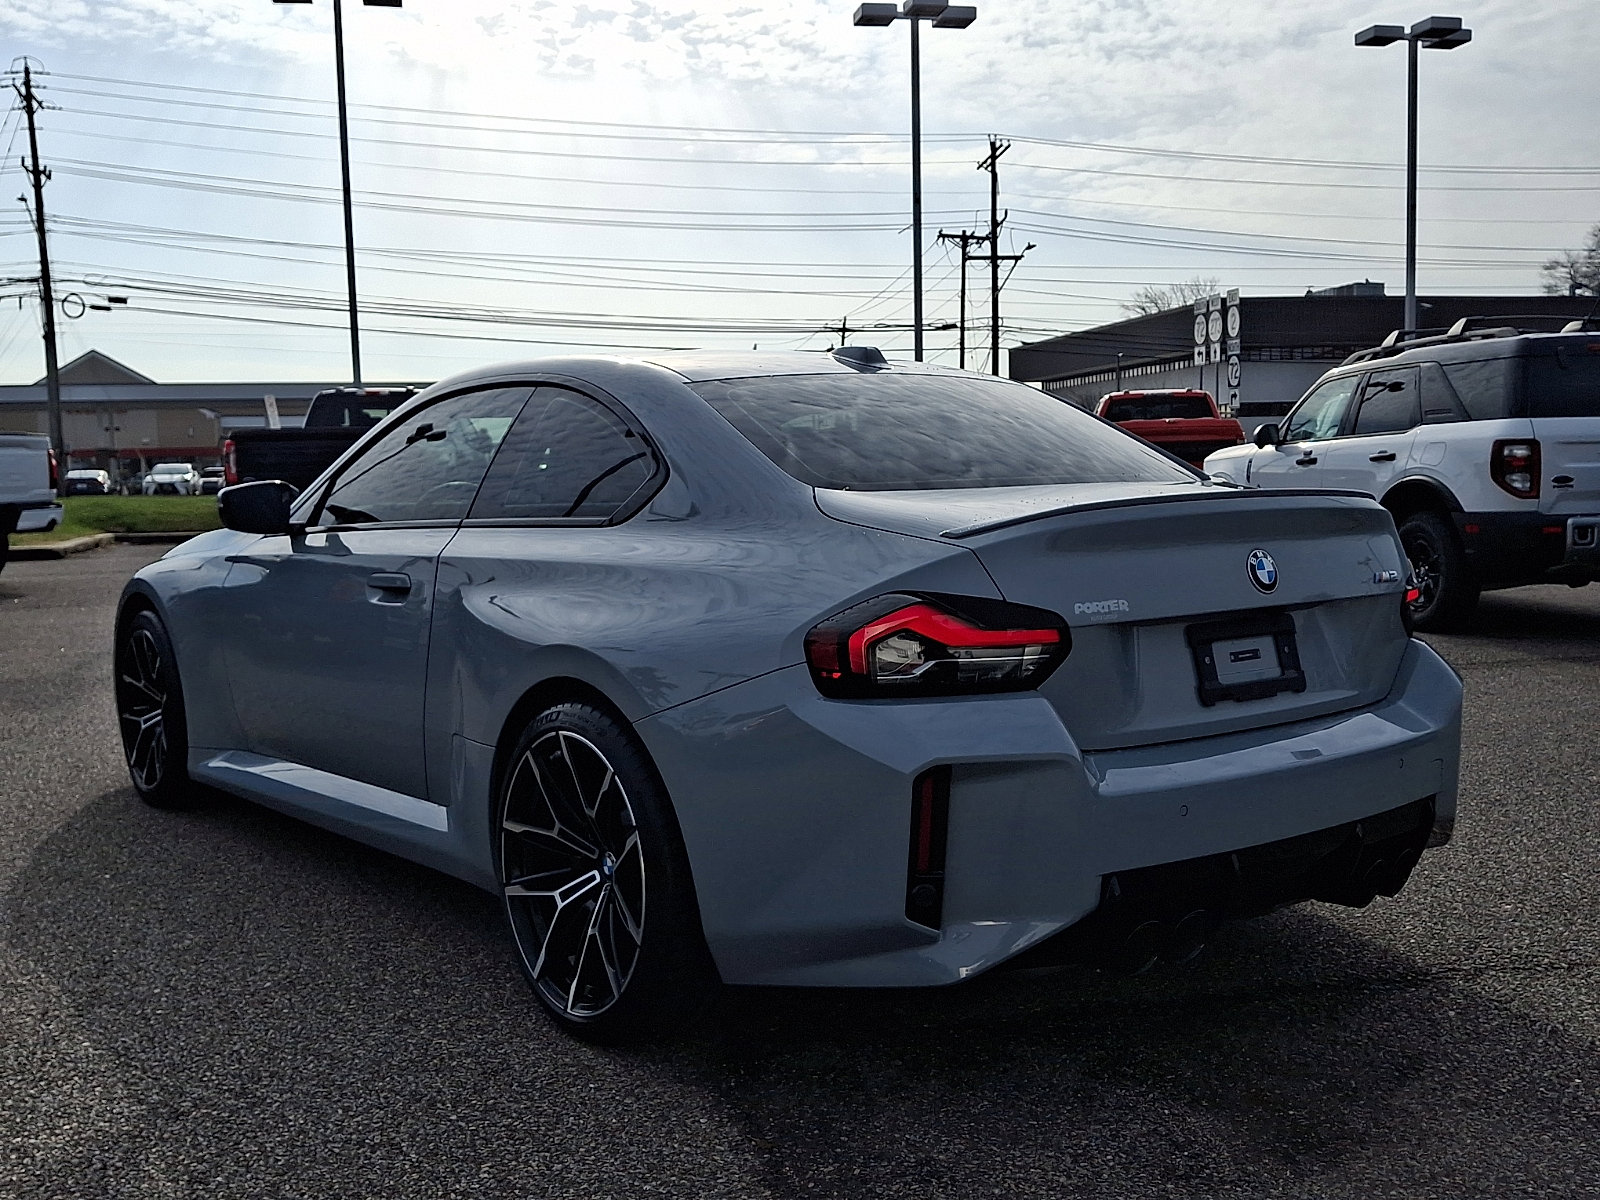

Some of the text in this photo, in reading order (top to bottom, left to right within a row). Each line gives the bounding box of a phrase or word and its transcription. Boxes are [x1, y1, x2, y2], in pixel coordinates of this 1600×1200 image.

[1196, 320, 1205, 338] 72
[1229, 361, 1239, 381] 72
[1250, 551, 1274, 565] BMW
[1074, 599, 1129, 615] PORTER
